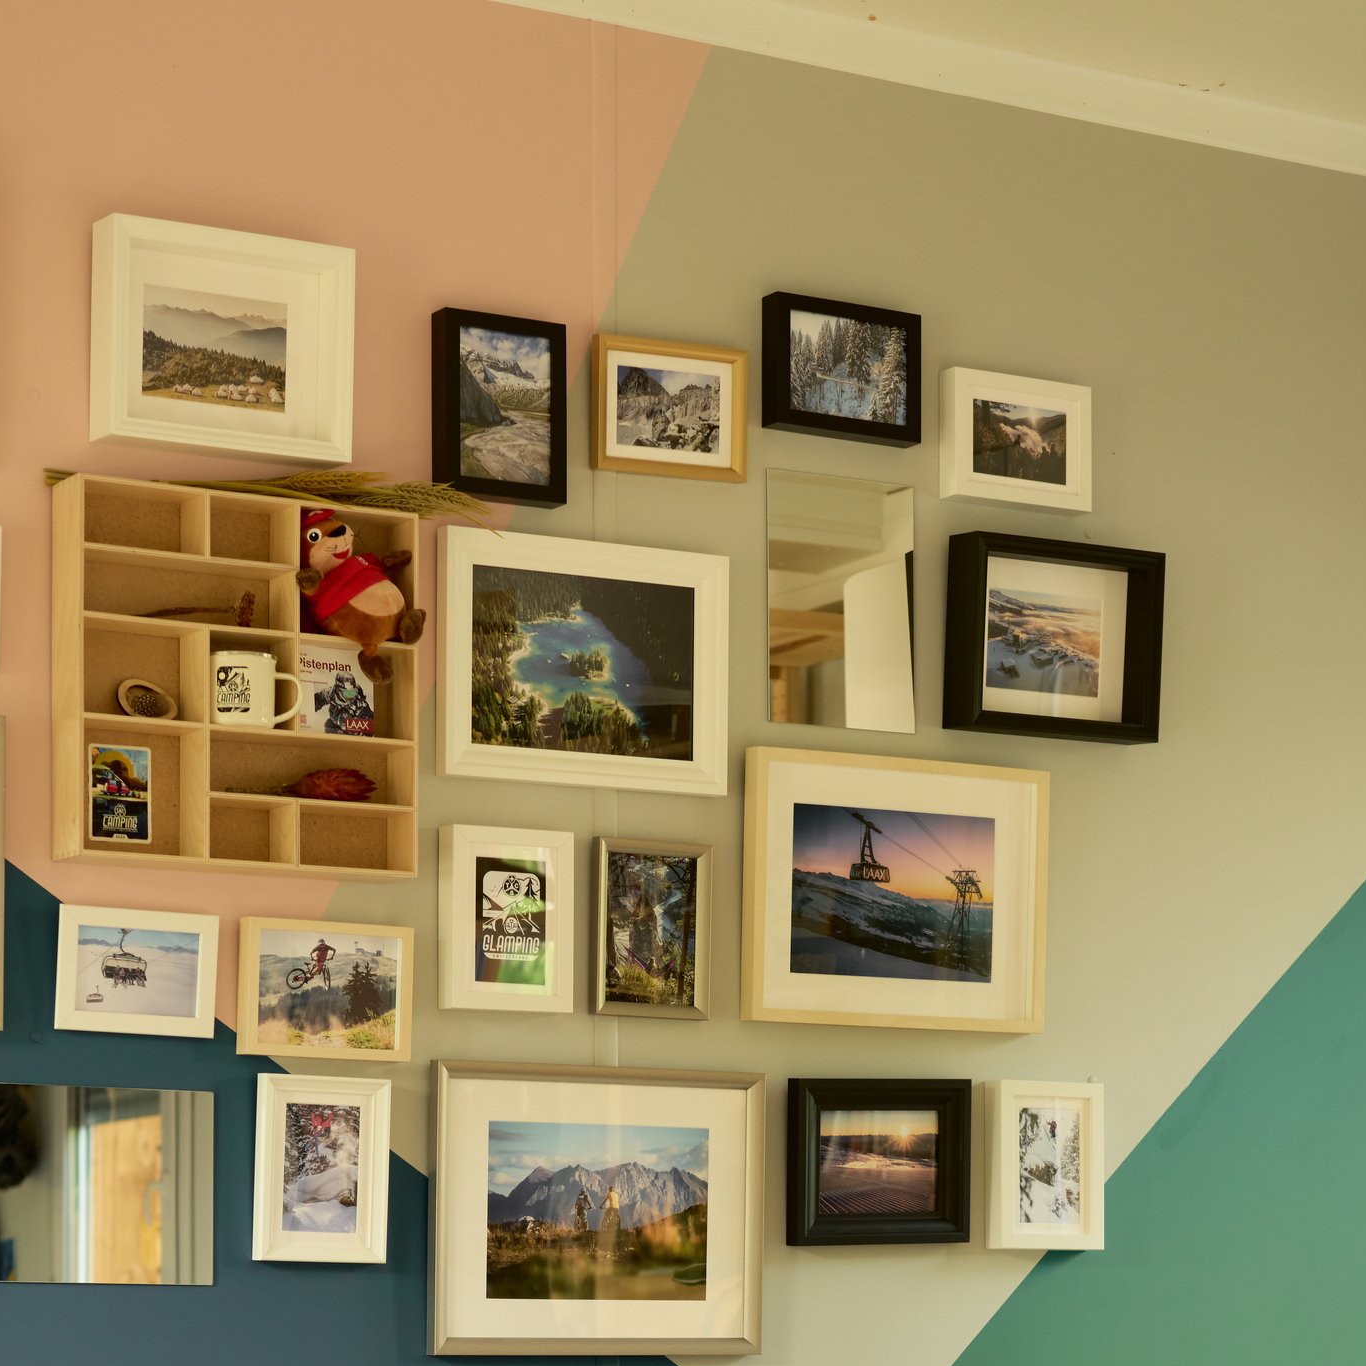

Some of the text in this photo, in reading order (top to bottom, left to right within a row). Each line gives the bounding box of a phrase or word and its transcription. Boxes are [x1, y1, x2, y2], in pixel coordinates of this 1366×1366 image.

[217, 693, 250, 704] CAMPING
[346, 719, 369, 730] LAAX
[103, 816, 137, 828] CAMPING
[863, 866, 885, 881] LAAX
[483, 934, 539, 953] GLAMPING
